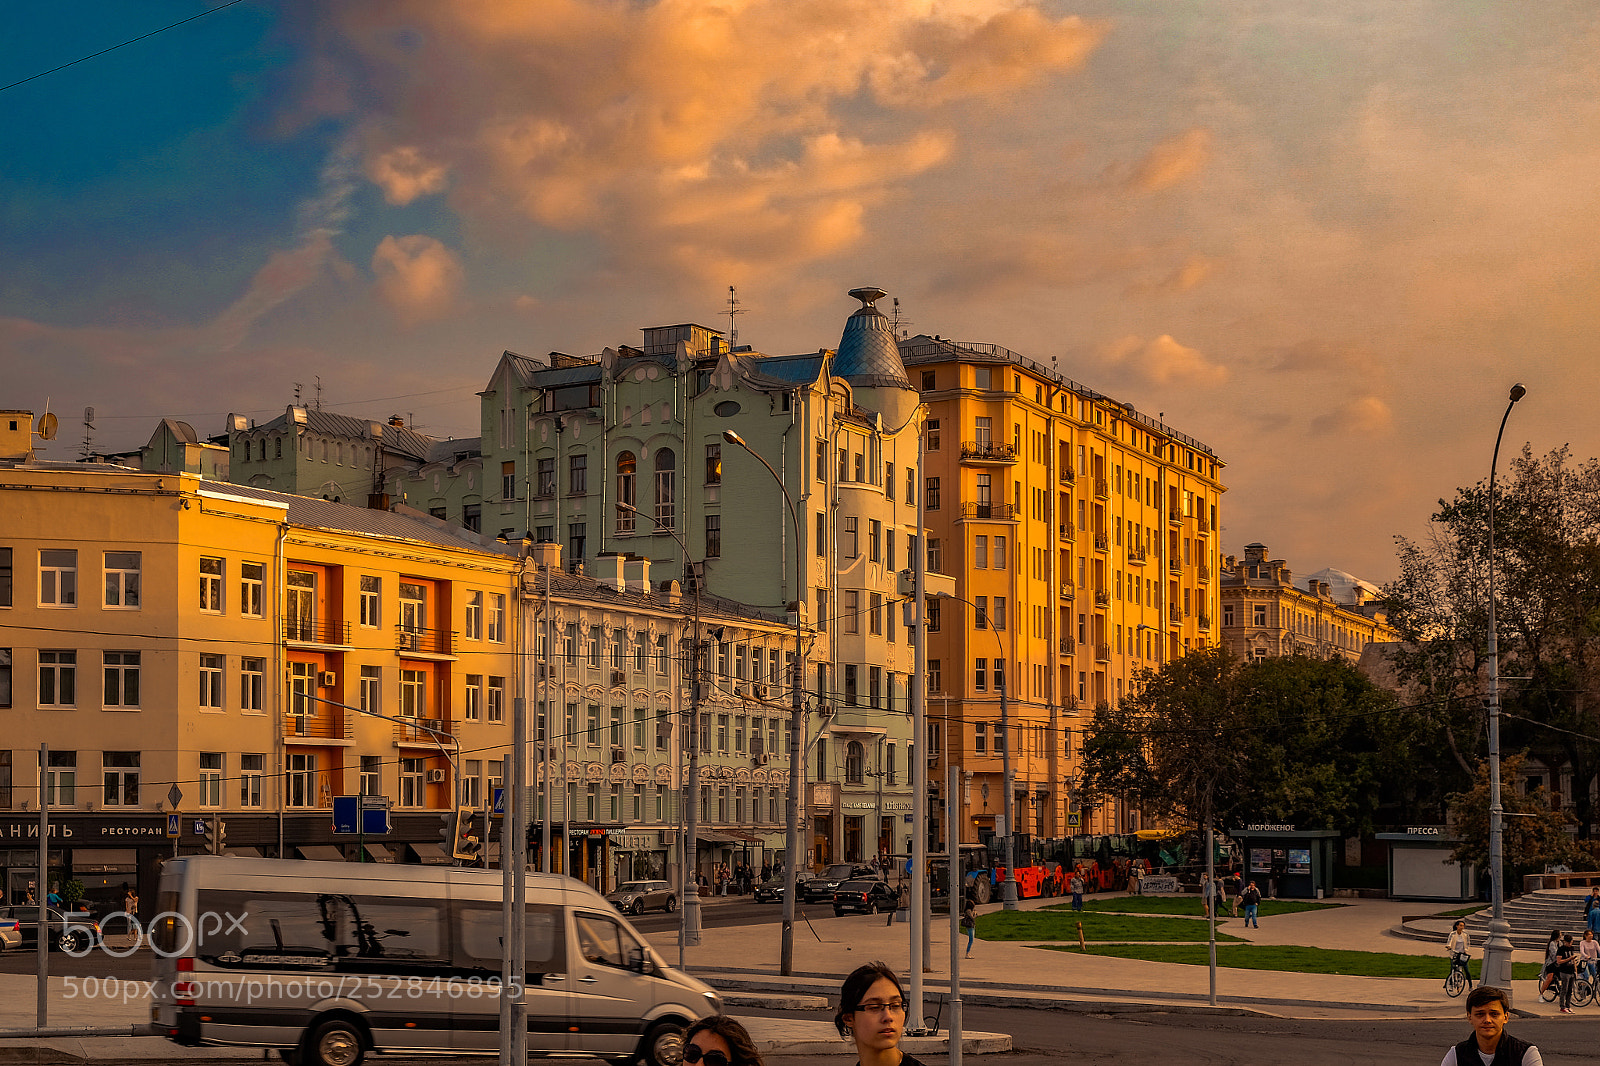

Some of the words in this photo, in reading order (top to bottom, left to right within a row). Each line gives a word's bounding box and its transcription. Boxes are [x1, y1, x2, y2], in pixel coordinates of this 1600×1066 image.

[101, 827, 162, 835] РЕСТОРАН
[1247, 824, 1296, 832] МОРОЖЕНОЕ
[1407, 827, 1439, 835] ПРЕССА
